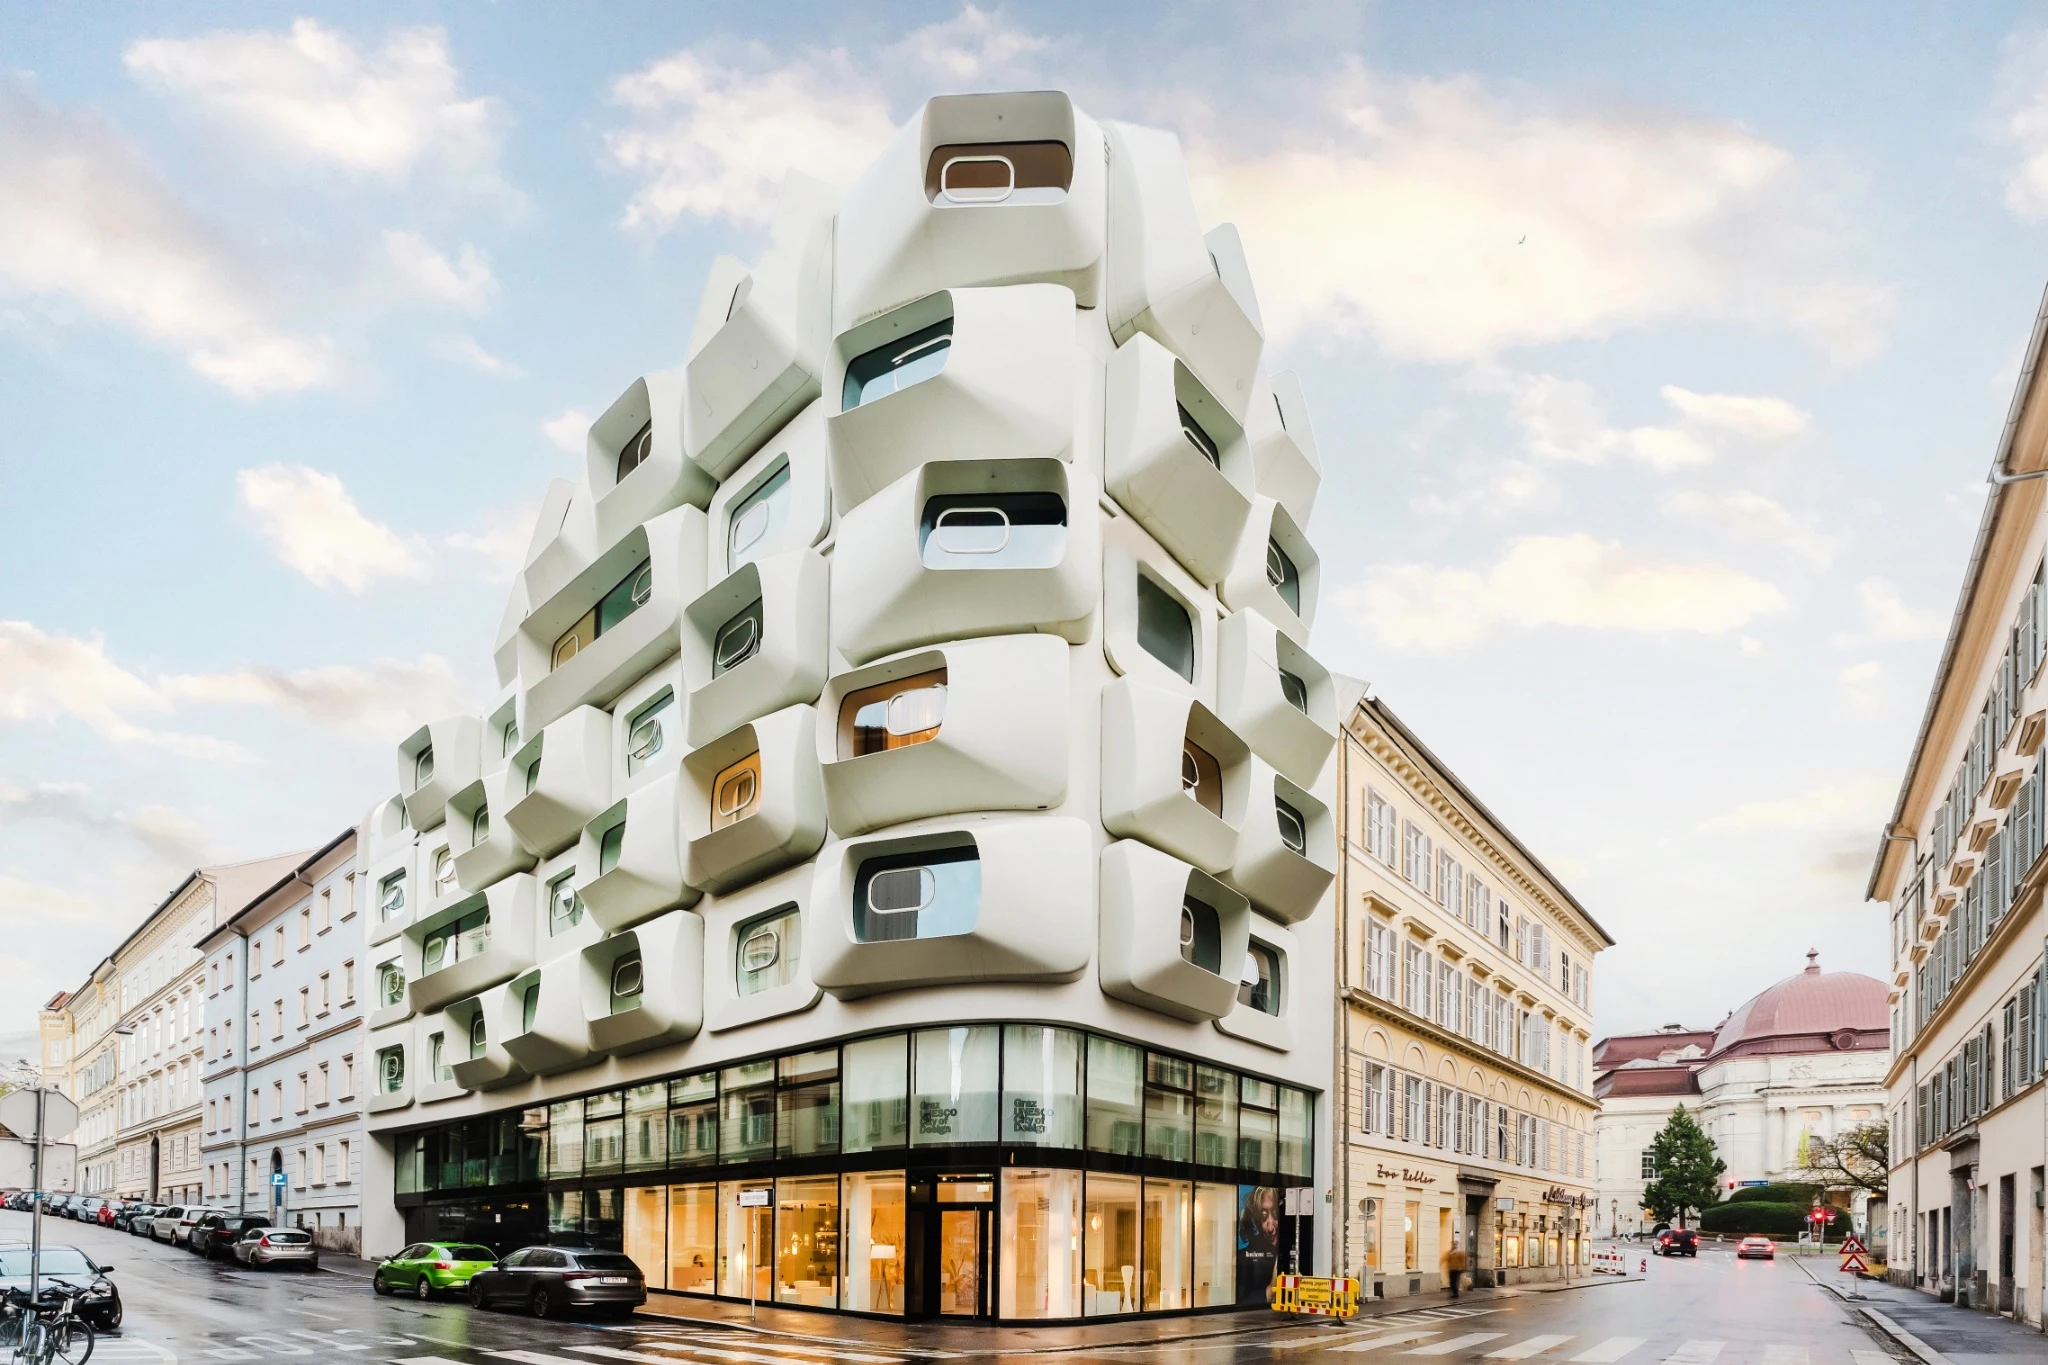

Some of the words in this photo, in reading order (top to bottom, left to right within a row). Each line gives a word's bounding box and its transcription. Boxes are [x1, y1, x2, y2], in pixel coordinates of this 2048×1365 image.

[920, 1101, 940, 1110] Graz
[1014, 1099, 1037, 1107] Graz
[920, 1108, 957, 1117] UNESCO
[1014, 1108, 1054, 1117] UNESCO
[938, 1116, 949, 1125] of
[1035, 1116, 1046, 1124] of
[274, 1174, 283, 1182] P
